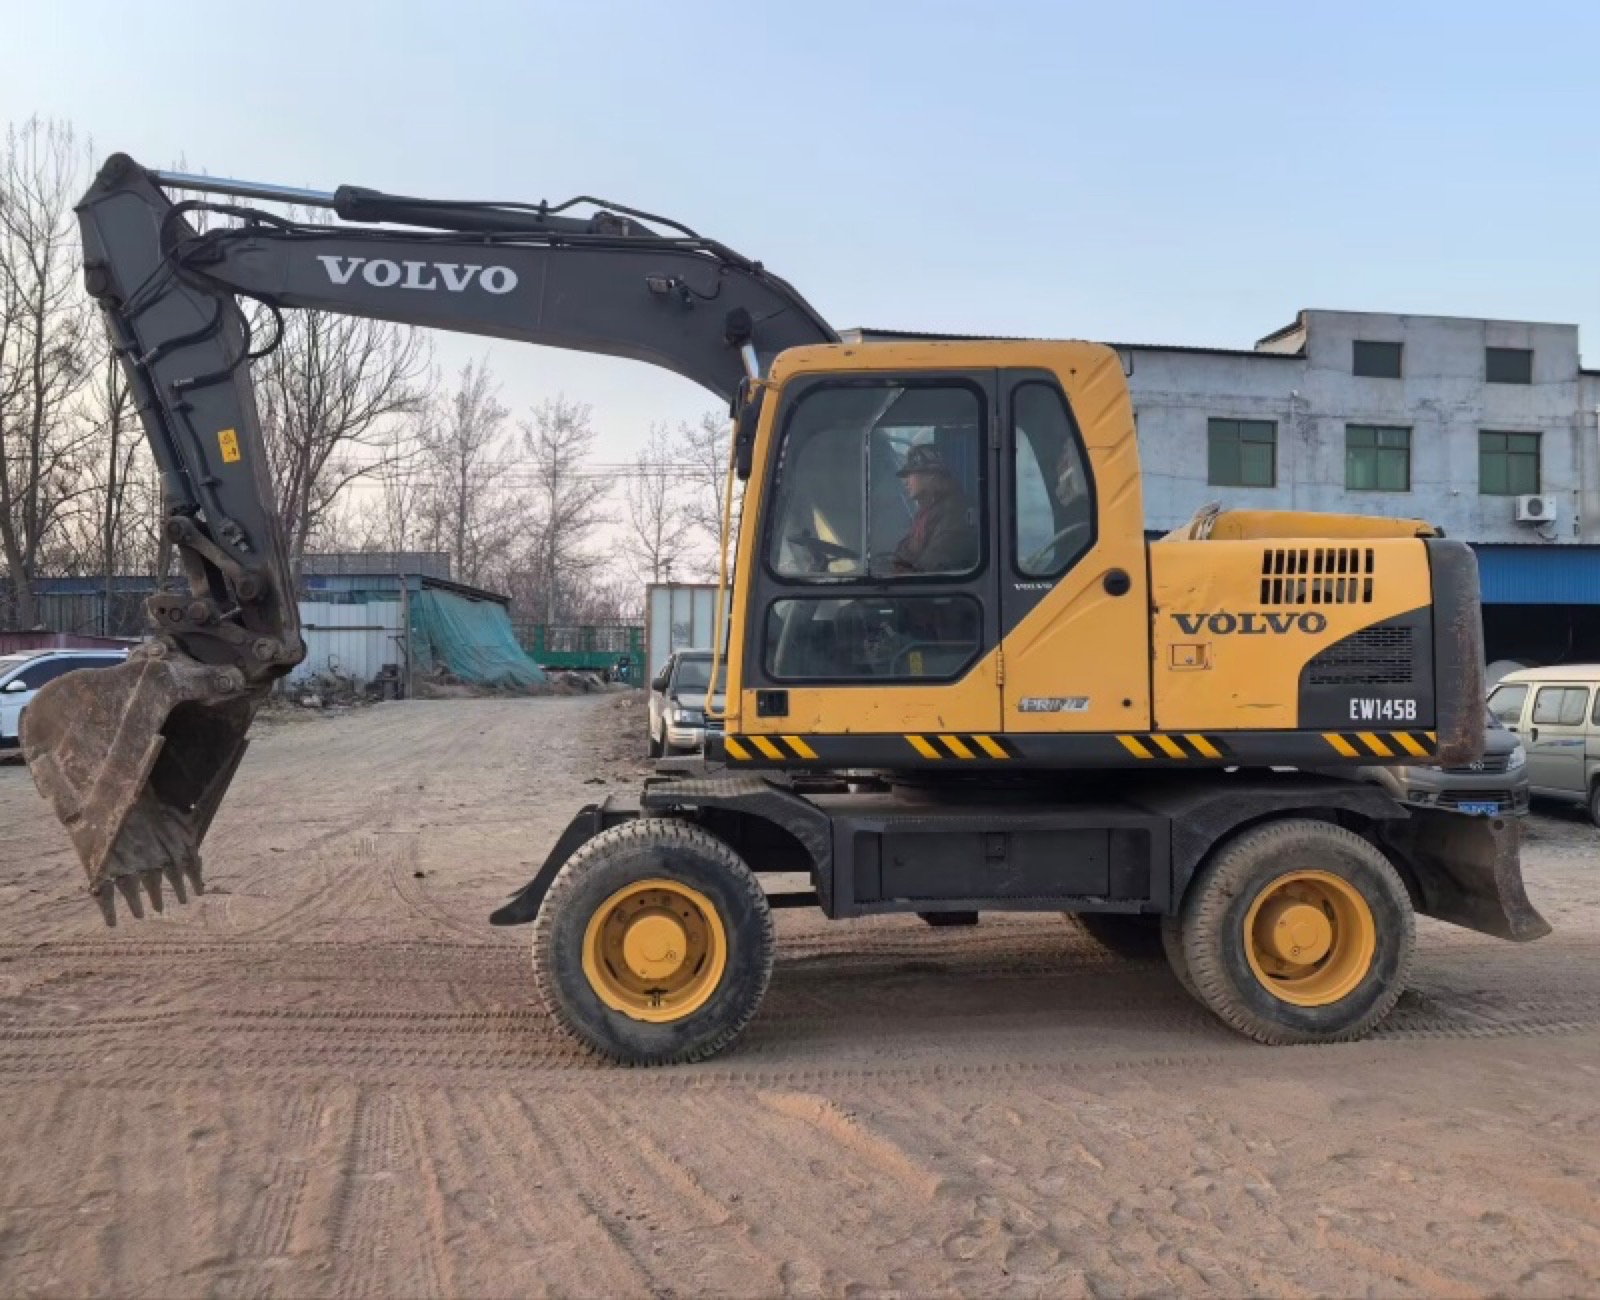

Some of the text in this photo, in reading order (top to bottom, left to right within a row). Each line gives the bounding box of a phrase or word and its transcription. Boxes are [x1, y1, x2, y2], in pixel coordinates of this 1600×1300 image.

[316, 255, 518, 294] VOLVO
[1170, 611, 1327, 635] VOLVO
[1349, 698, 1417, 720] EW145B
